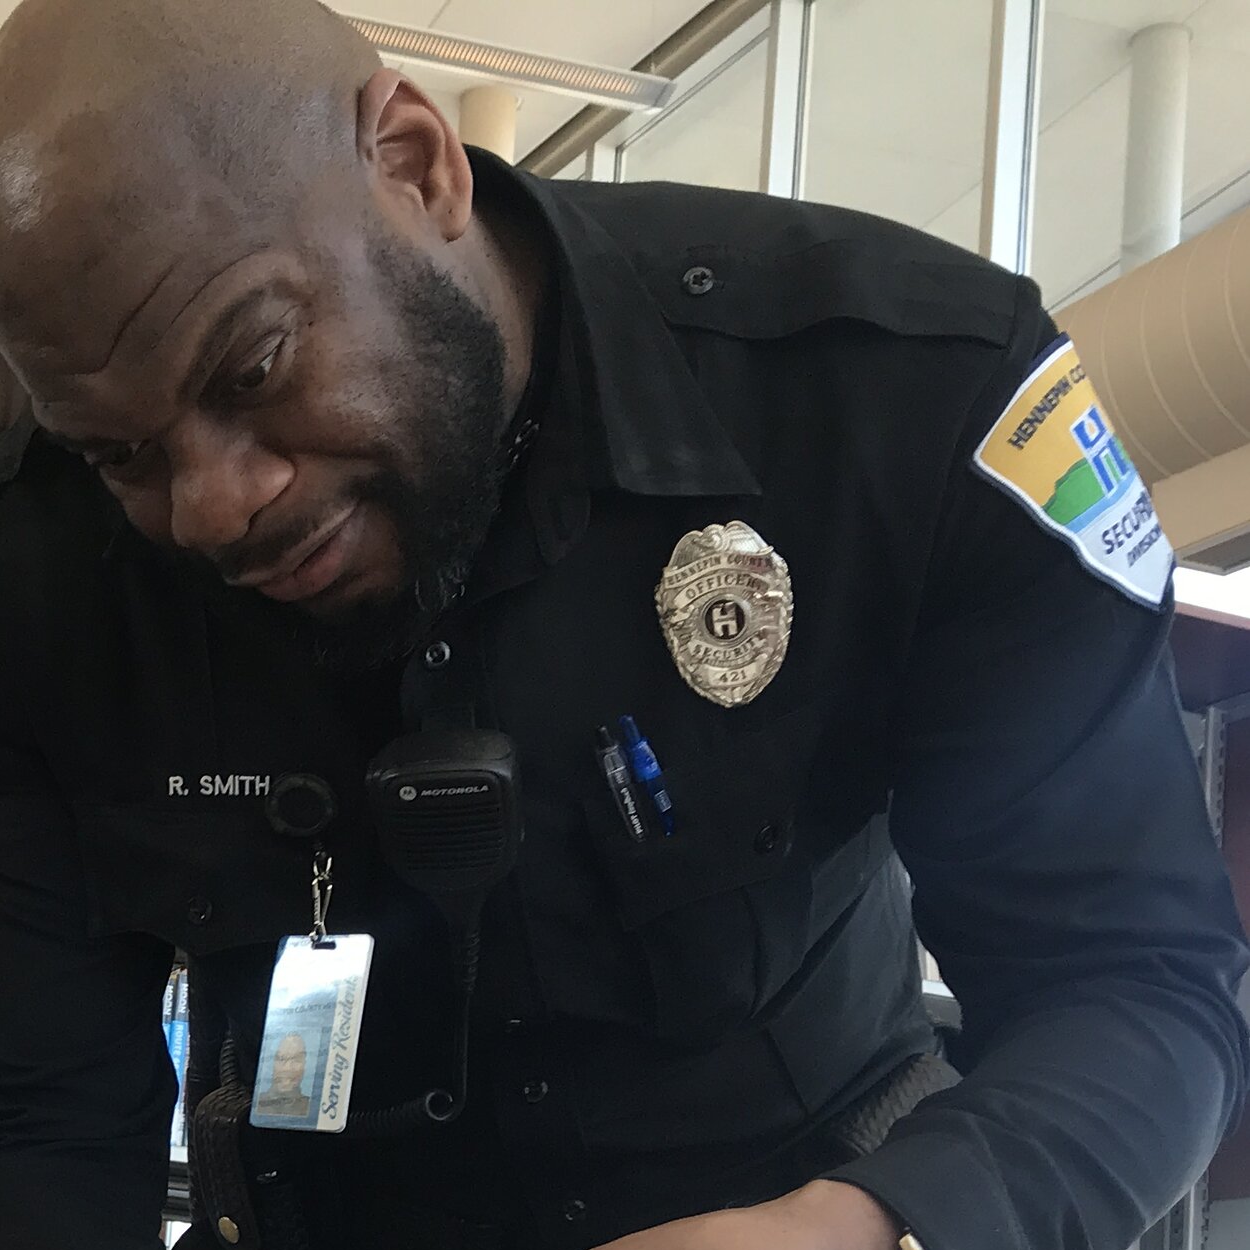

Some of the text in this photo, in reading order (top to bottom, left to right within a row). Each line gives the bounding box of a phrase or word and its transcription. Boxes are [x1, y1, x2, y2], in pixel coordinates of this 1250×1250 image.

[1007, 364, 1087, 449] HENNEPIN CO
[667, 552, 721, 586] HENNEPIN
[685, 573, 768, 599] OFFICER
[690, 636, 767, 660] SECURITY
[719, 669, 748, 683] 421
[168, 774, 271, 796] R. SMITH
[420, 784, 489, 797] MOTOROLA
[163, 985, 174, 1016] MOON
[178, 983, 189, 1014] MOON
[173, 1024, 183, 1056] ROUTE
[321, 1052, 349, 1120] Serving
